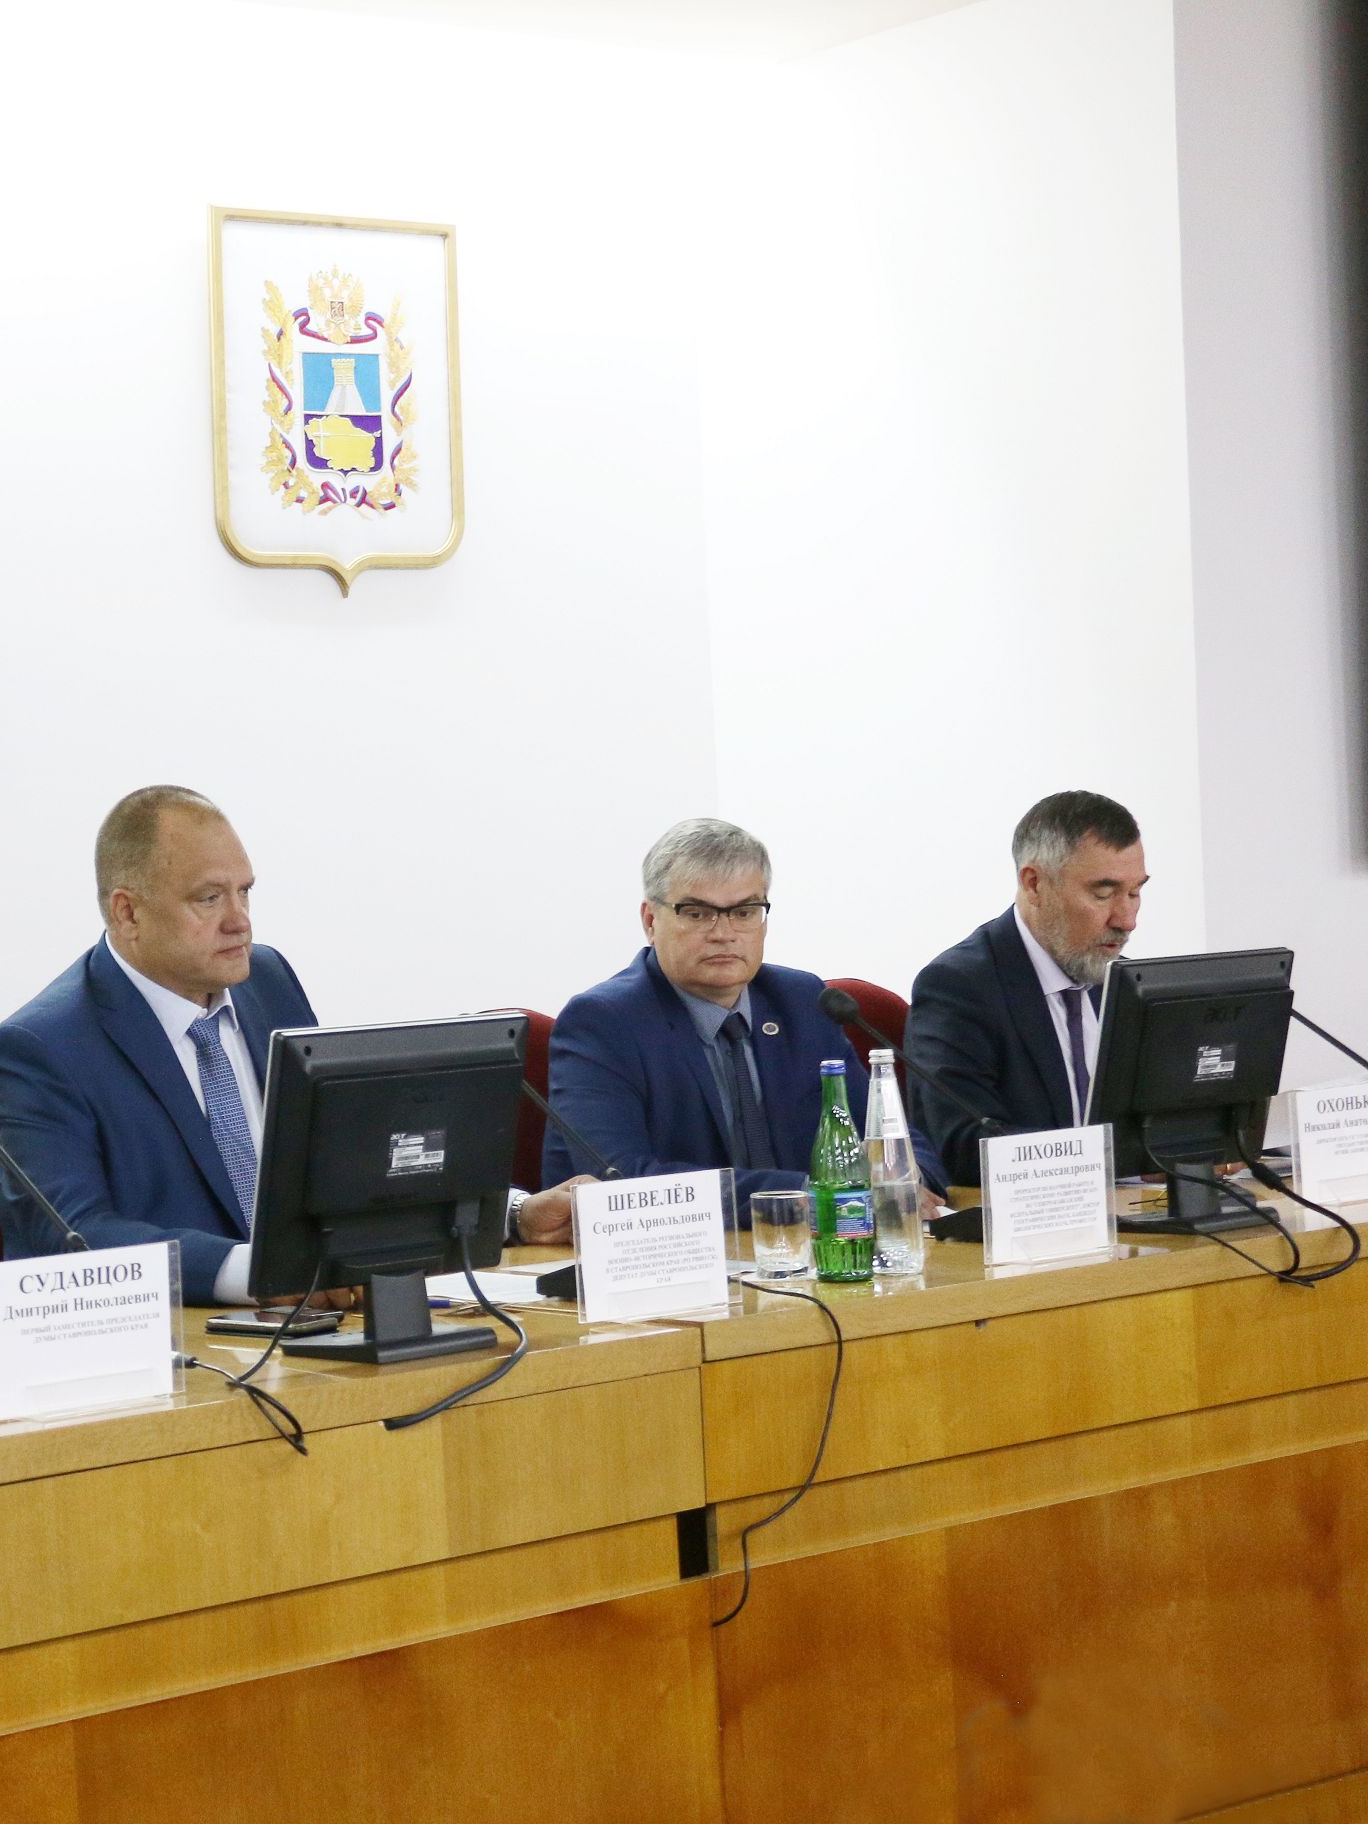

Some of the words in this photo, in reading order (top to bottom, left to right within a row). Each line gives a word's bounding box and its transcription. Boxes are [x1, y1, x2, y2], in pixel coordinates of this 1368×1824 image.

[1304, 1119, 1341, 1133] Николай
[1011, 1140, 1083, 1162] ЛИХОВИД
[994, 1170, 1028, 1184] Андрей
[1031, 1163, 1101, 1179] Александрович
[608, 1183, 695, 1212] ШЕВЕЛЁВ
[593, 1219, 633, 1236] Сергей
[637, 1212, 711, 1231] Арнольдович
[19, 1262, 143, 1294] СУДАВЦОВ
[3, 1300, 68, 1321] Дмитрий
[74, 1292, 159, 1311] Николаевич
